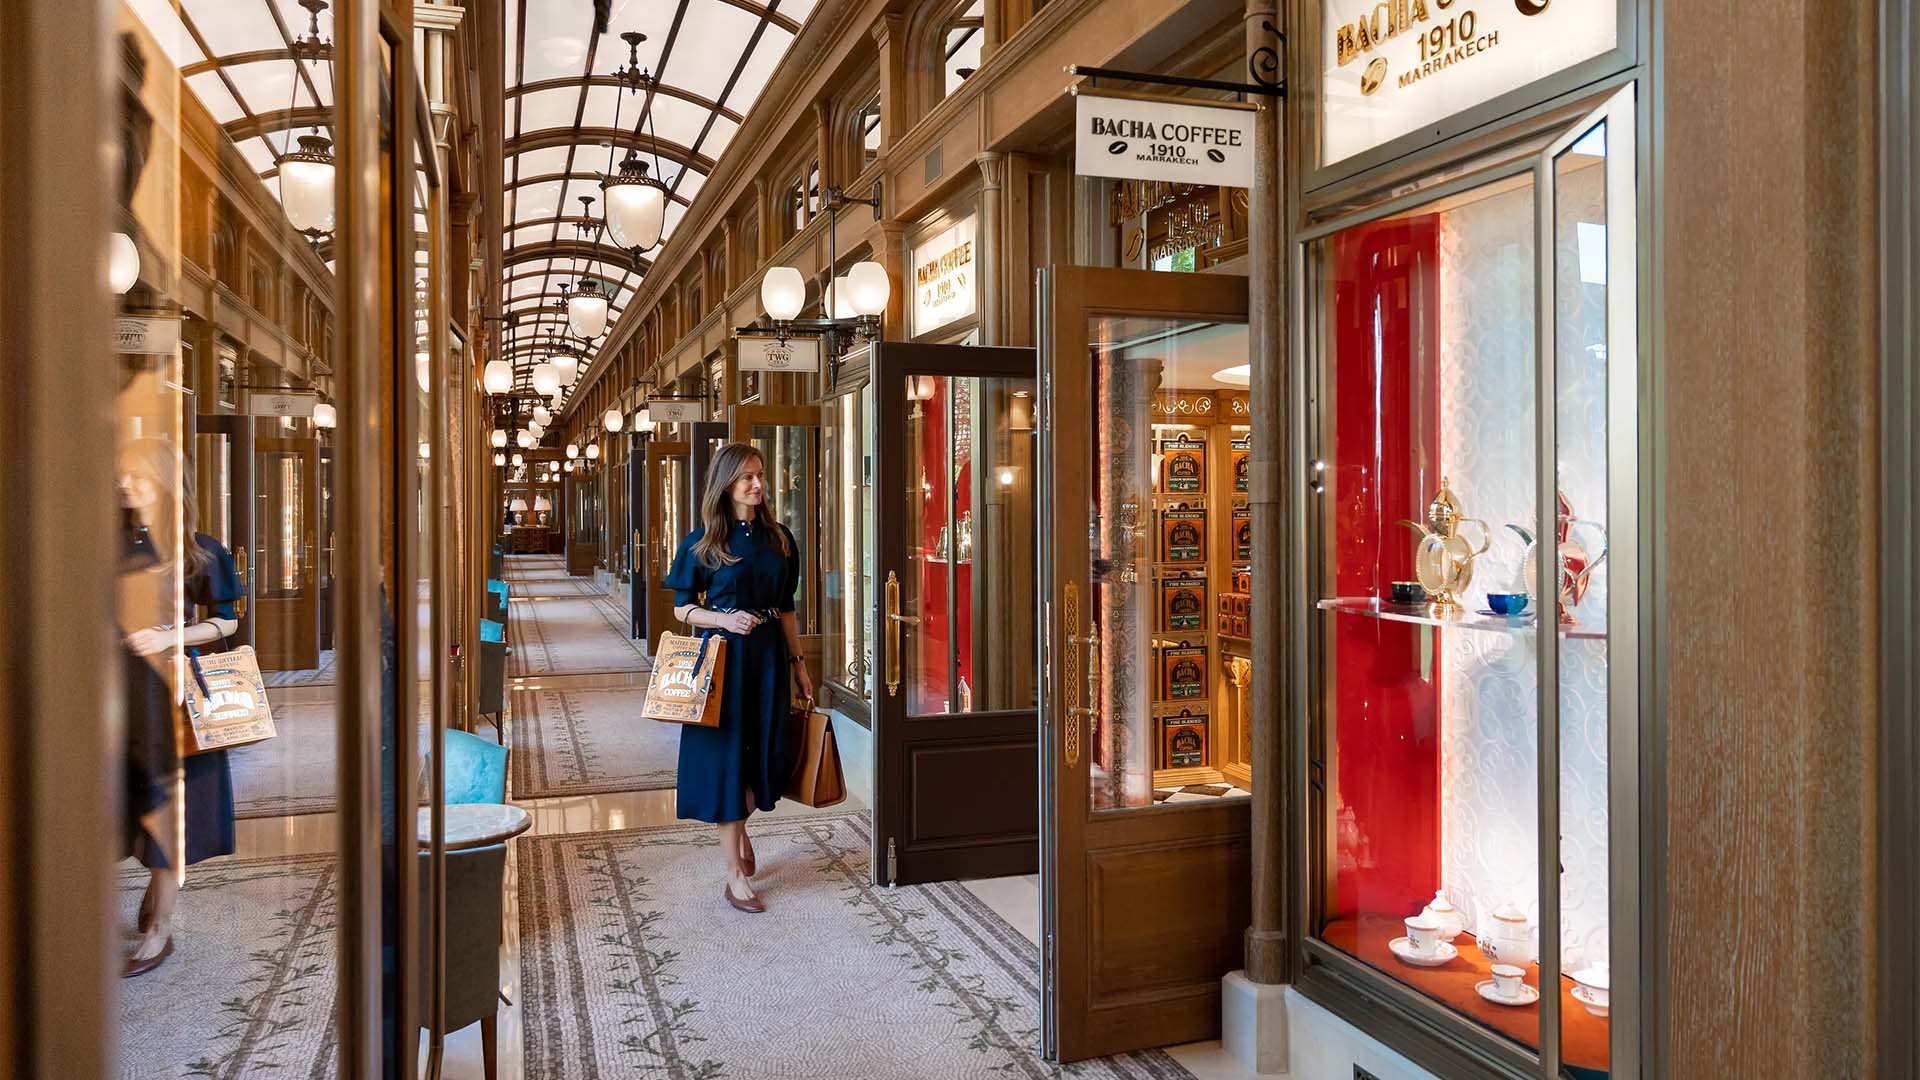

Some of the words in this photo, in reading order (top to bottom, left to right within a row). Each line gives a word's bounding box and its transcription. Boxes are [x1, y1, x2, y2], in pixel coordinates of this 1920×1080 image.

[1337, 0, 1430, 67] BACHA
[1417, 10, 1477, 61] 1910
[1398, 31, 1499, 88] MARRAKECH
[1091, 117, 1157, 140] BACHA
[1161, 123, 1242, 146] COFFEE
[1136, 154, 1199, 165] MARRAKECH
[1149, 143, 1186, 158] 1910
[767, 353, 789, 361] TWG
[660, 671, 698, 693] BACHA
